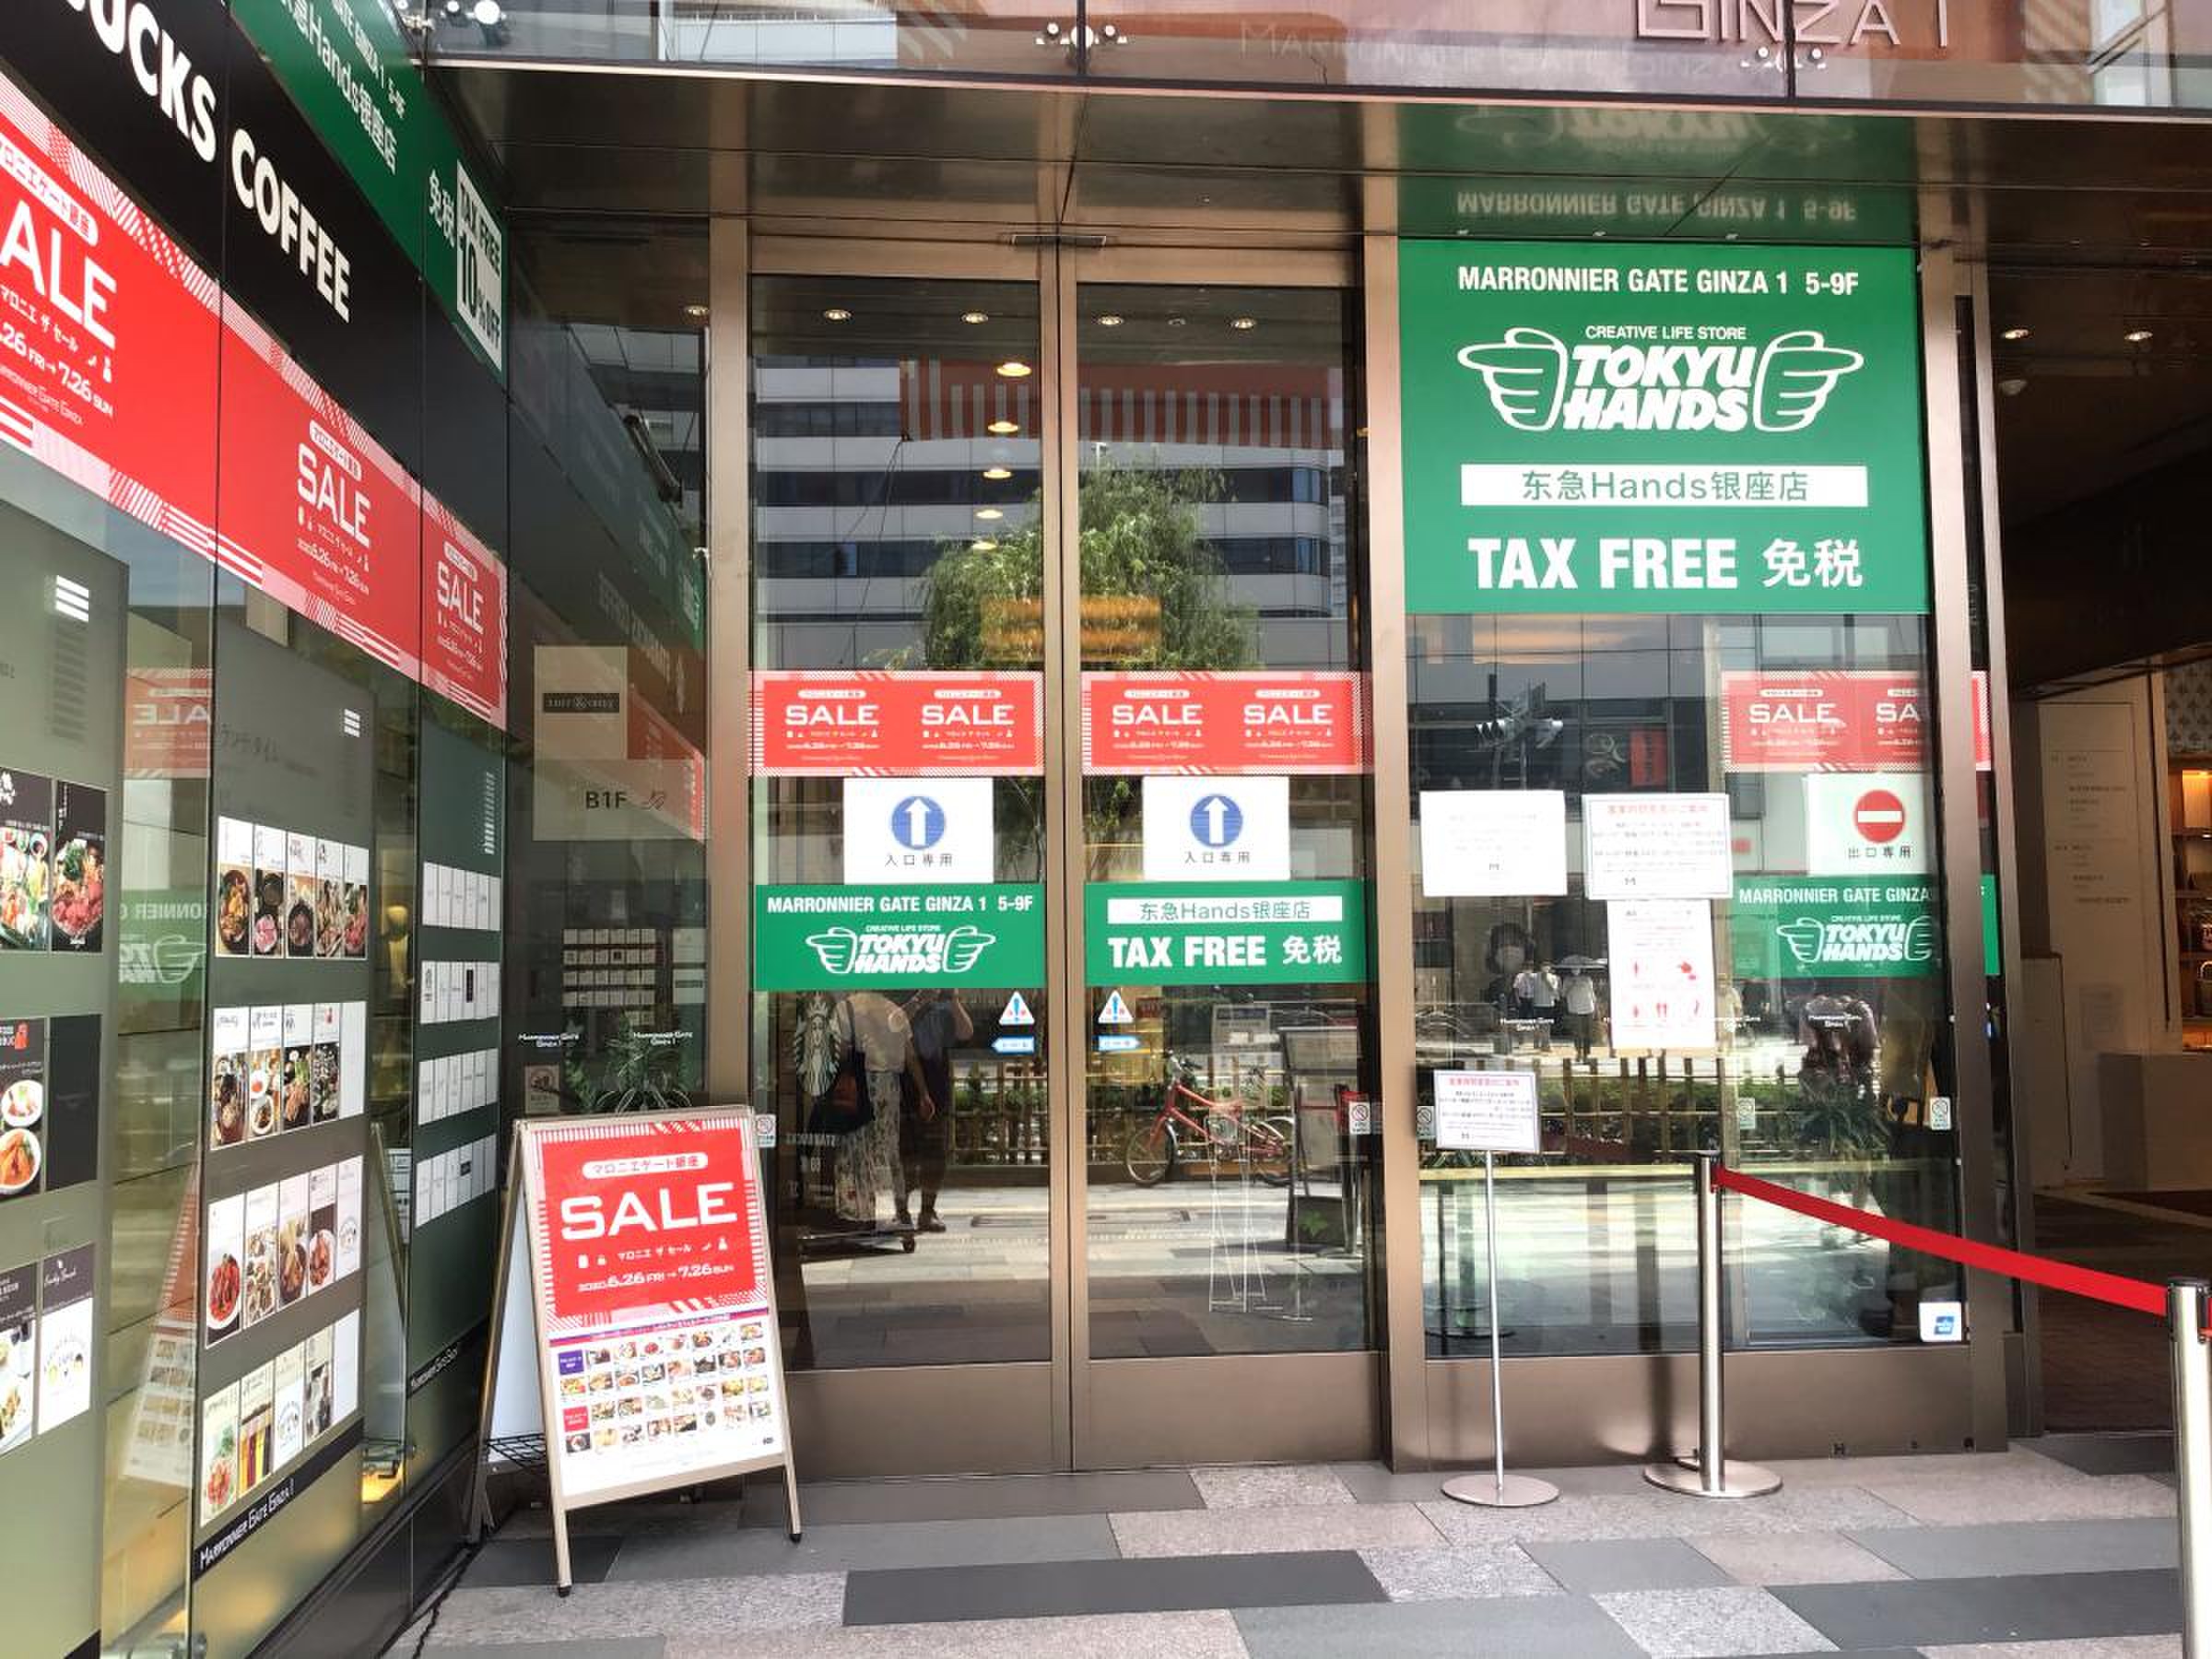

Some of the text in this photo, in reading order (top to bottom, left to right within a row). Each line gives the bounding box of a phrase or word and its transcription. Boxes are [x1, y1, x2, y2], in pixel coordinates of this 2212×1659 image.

[66, 0, 350, 324] UCKS COFFEE
[1458, 265, 1859, 296] MARRONNIER GATE GINZA 1 5-9F
[1585, 325, 1747, 340] CREATIVE LIFE STORE
[1571, 345, 1757, 389] TOKYU
[1563, 388, 1749, 432] HANDS
[298, 442, 371, 548] SALE
[1521, 469, 1809, 502] 东急Hands银座店
[1468, 537, 1864, 590] TAX FREE 免税
[437, 559, 485, 636] SALE
[785, 704, 1015, 726] SALE SALE
[1112, 703, 1334, 725] SALE SALE
[1748, 702, 1837, 724] SALE
[585, 790, 628, 810] B1F
[884, 853, 953, 866] 入口専用
[1184, 851, 1251, 865] 入口専用
[1848, 845, 1912, 858] 出口専用
[767, 894, 1033, 913] MARRONNIER GATE GINZA 1 5-9F
[1739, 887, 1929, 904] MARRONNIER GATE GINZA
[1139, 900, 1311, 921] 东急Hands银座店
[858, 933, 947, 954] TOKYU
[1825, 923, 1907, 943] TOKYU
[1108, 935, 1343, 969] TAX FREE 免税
[1822, 942, 1905, 962] HANDS
[855, 954, 942, 974] HANDS
[560, 1182, 738, 1241] SALE
